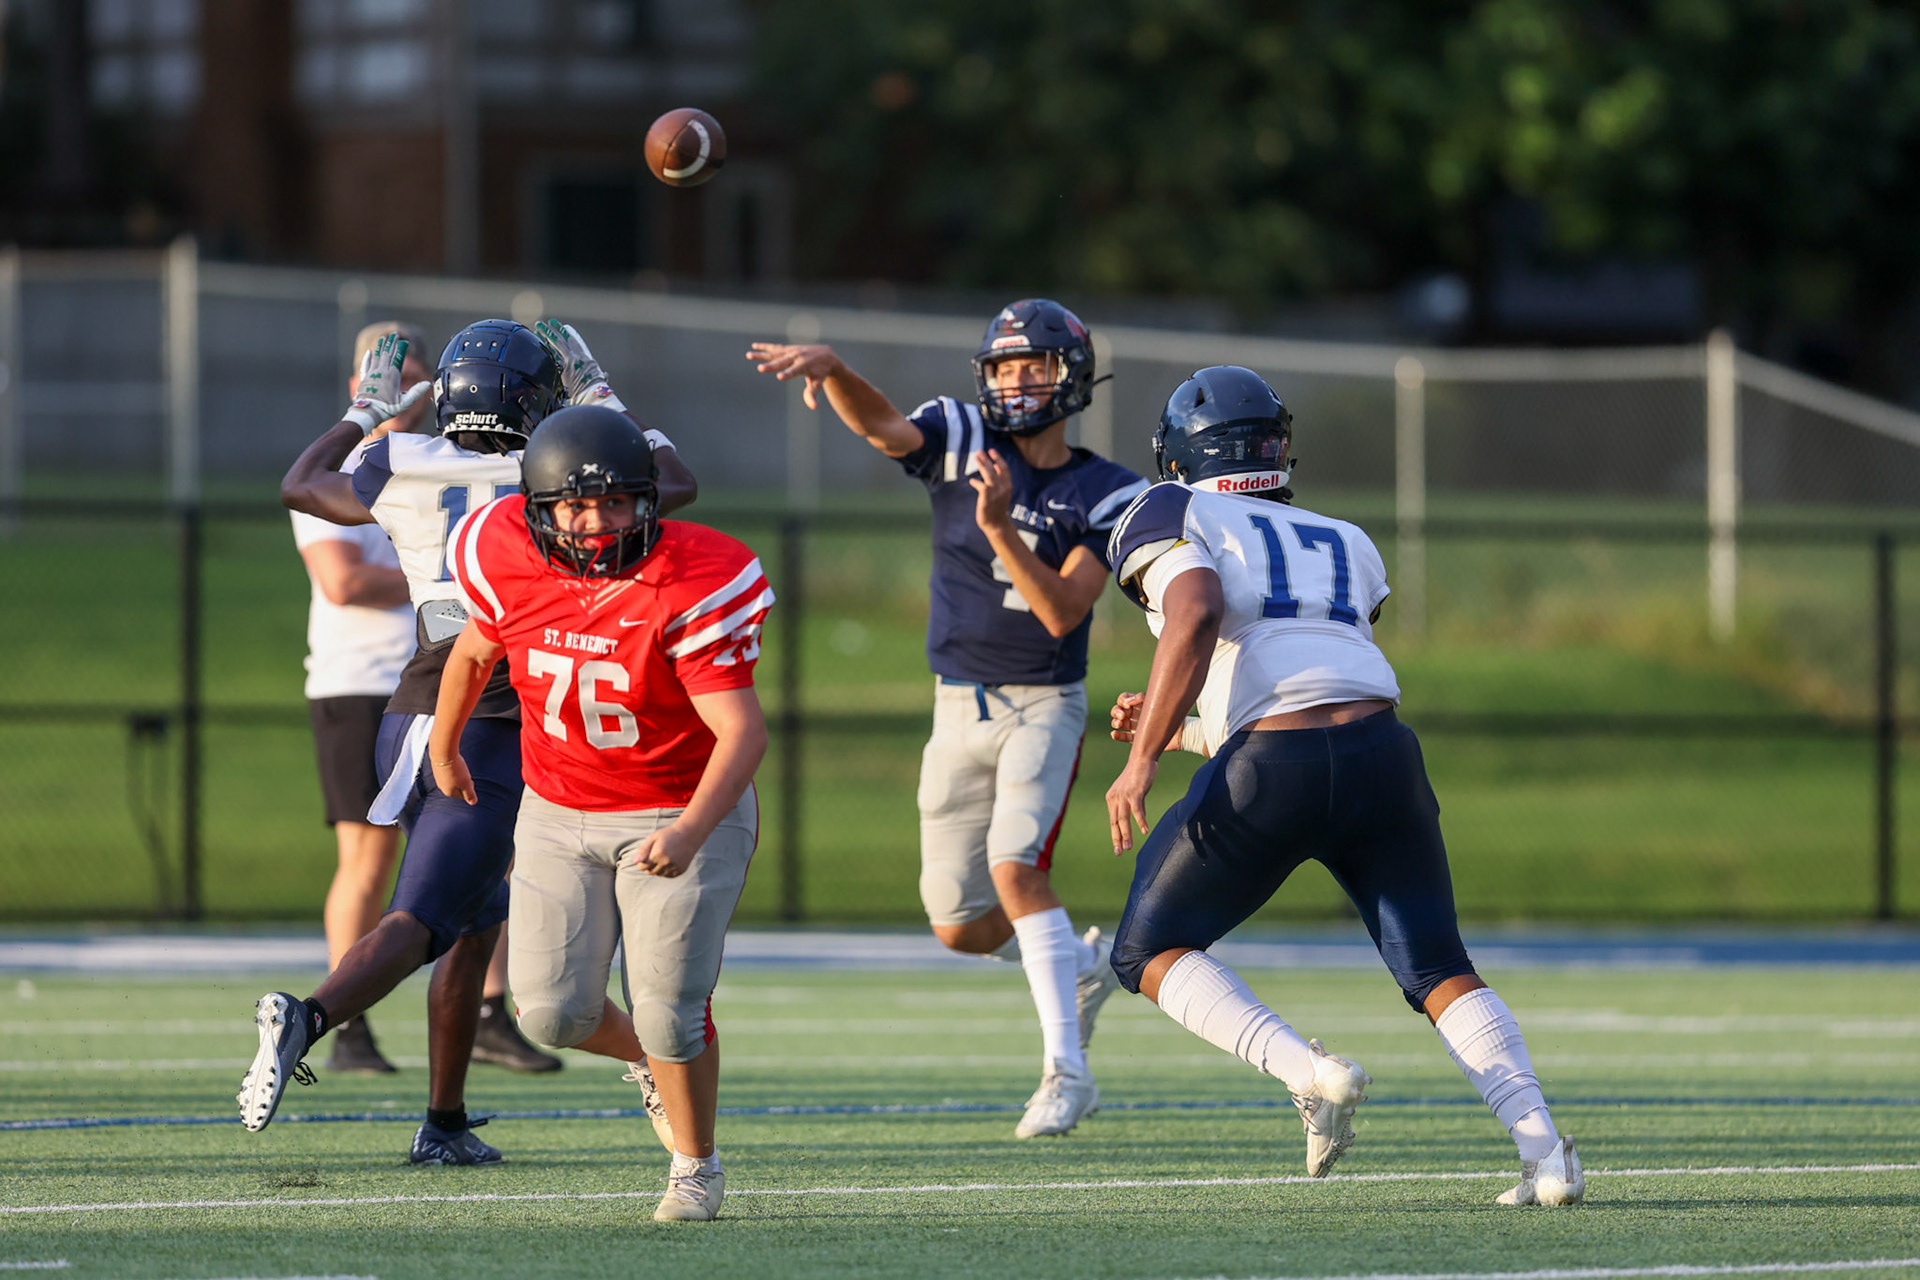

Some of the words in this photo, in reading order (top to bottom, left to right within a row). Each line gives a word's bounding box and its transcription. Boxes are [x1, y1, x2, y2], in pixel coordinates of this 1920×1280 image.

[1217, 474, 1279, 492] Riddell
[1246, 512, 1360, 627] 17
[543, 628, 562, 648] ST.
[564, 631, 619, 655] BENEDICT
[527, 647, 640, 750] 76
